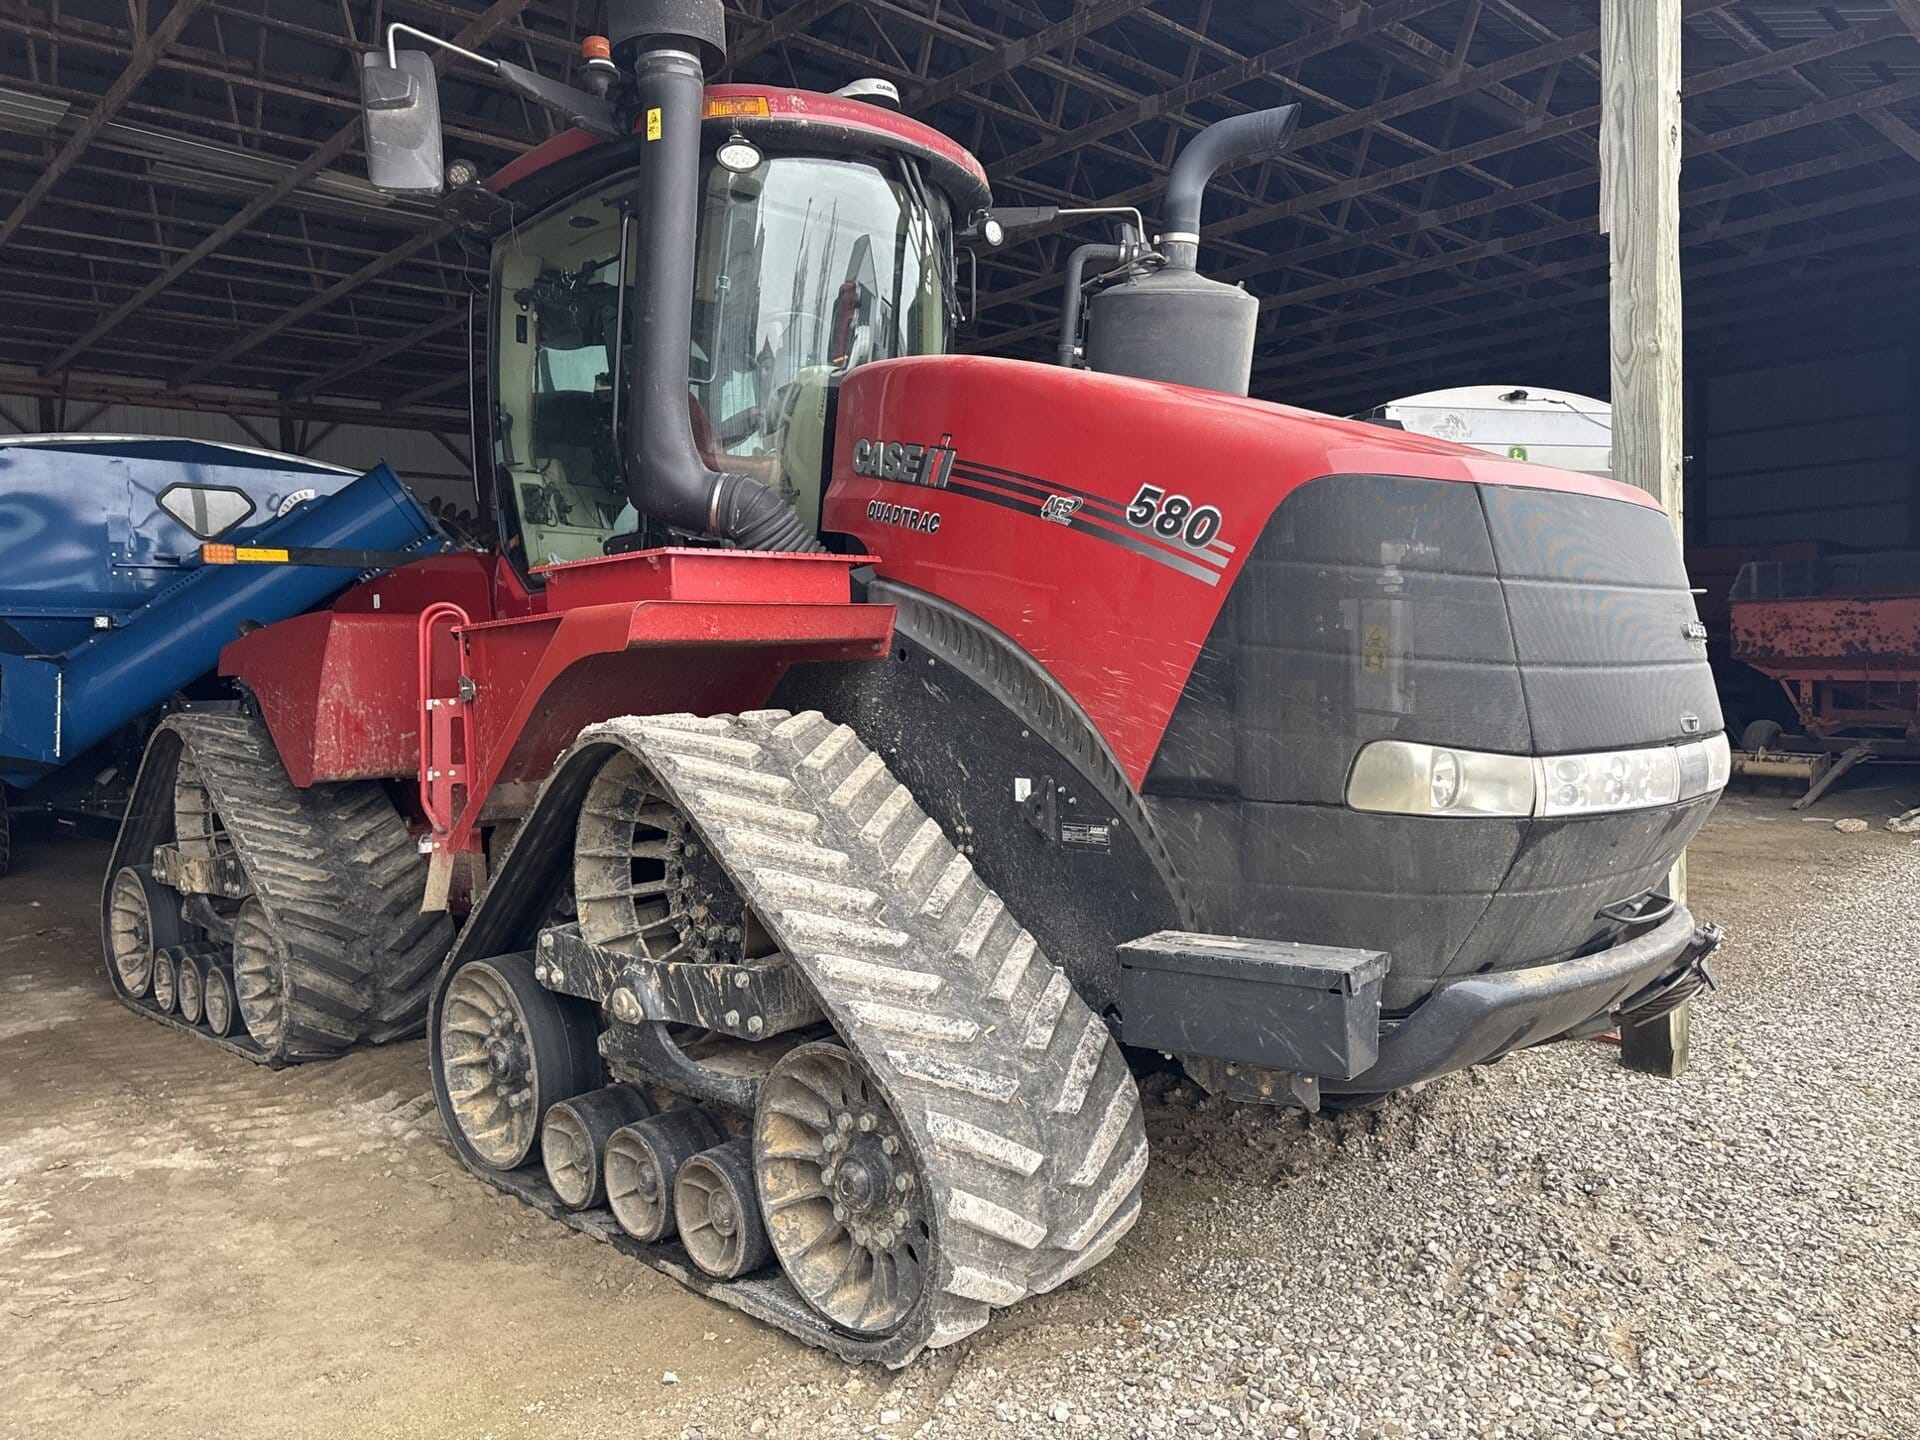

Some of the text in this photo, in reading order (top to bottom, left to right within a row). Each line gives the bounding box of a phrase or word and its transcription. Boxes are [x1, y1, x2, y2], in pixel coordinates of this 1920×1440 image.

[852, 438, 925, 484] CASE
[867, 499, 942, 534] QUADTRAC
[1041, 494, 1075, 517] AFS
[1126, 482, 1223, 550] 580
